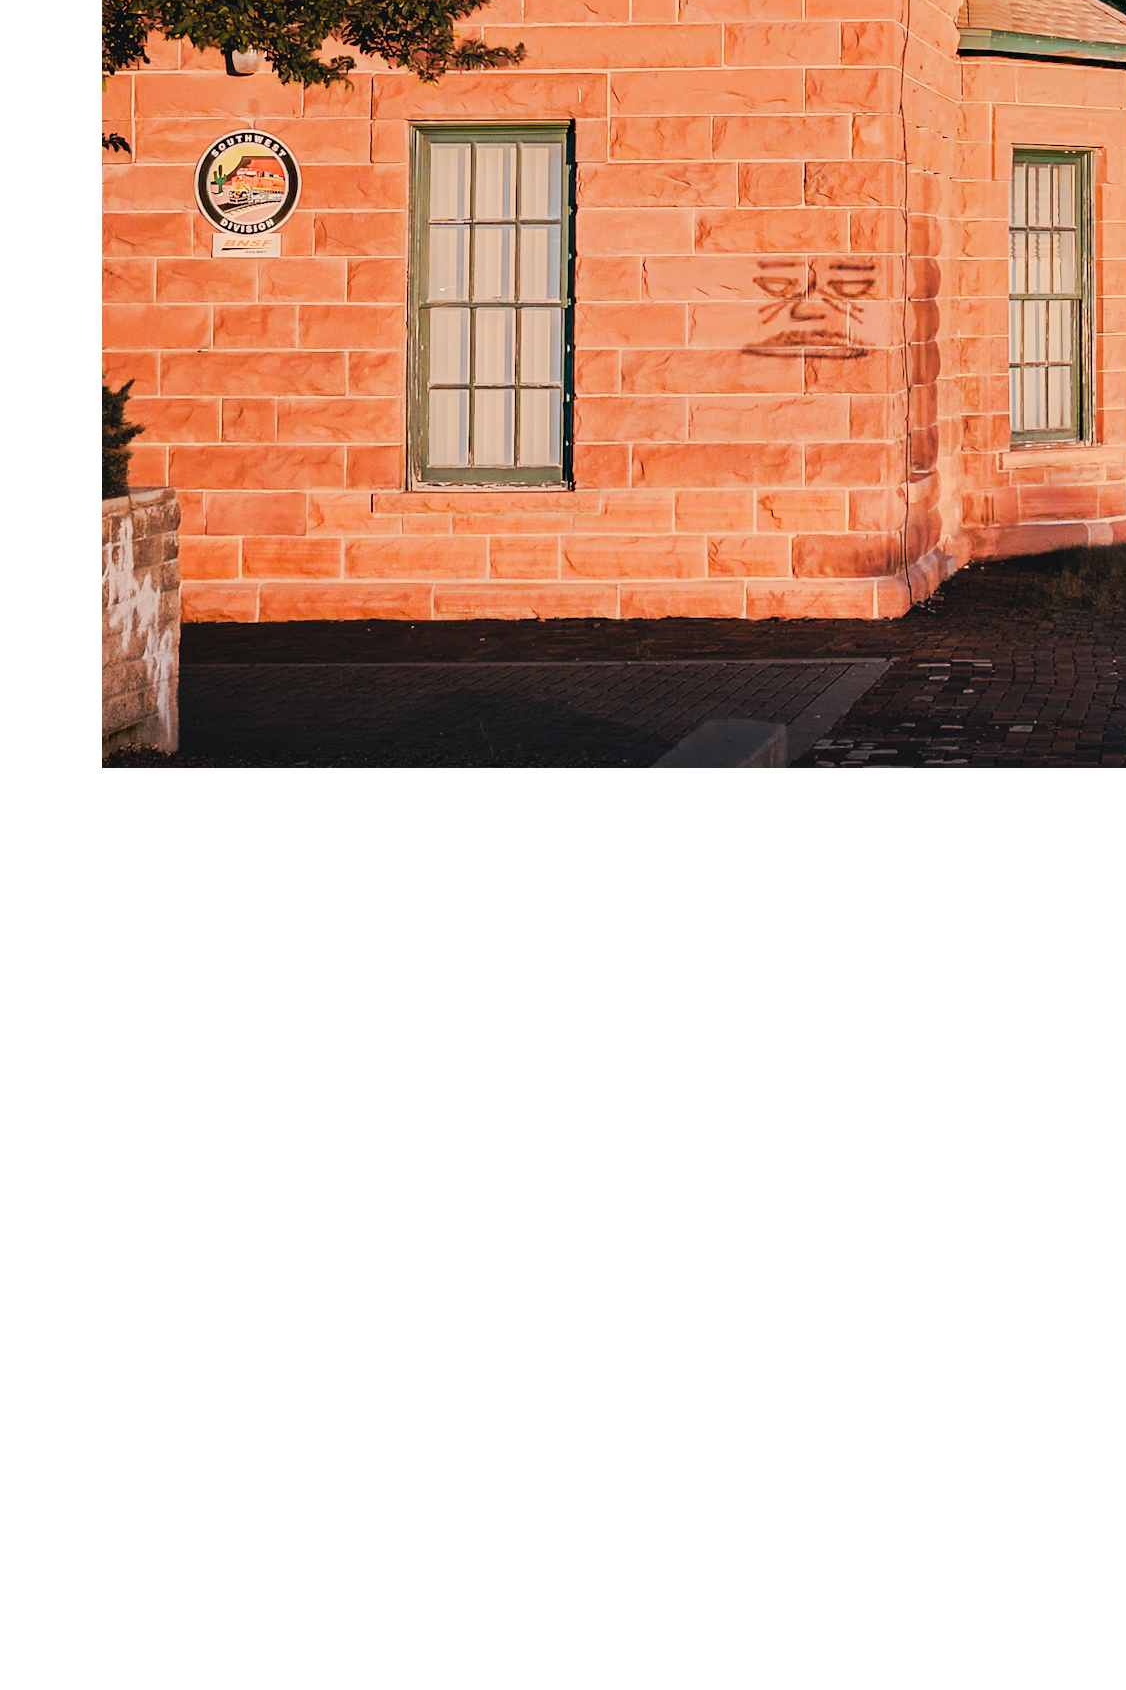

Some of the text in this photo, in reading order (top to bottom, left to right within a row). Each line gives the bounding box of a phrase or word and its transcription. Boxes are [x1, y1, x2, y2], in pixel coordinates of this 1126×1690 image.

[210, 133, 287, 158] SOUTHWEST
[220, 218, 275, 233] DIVISION
[224, 239, 273, 247] BNSF
